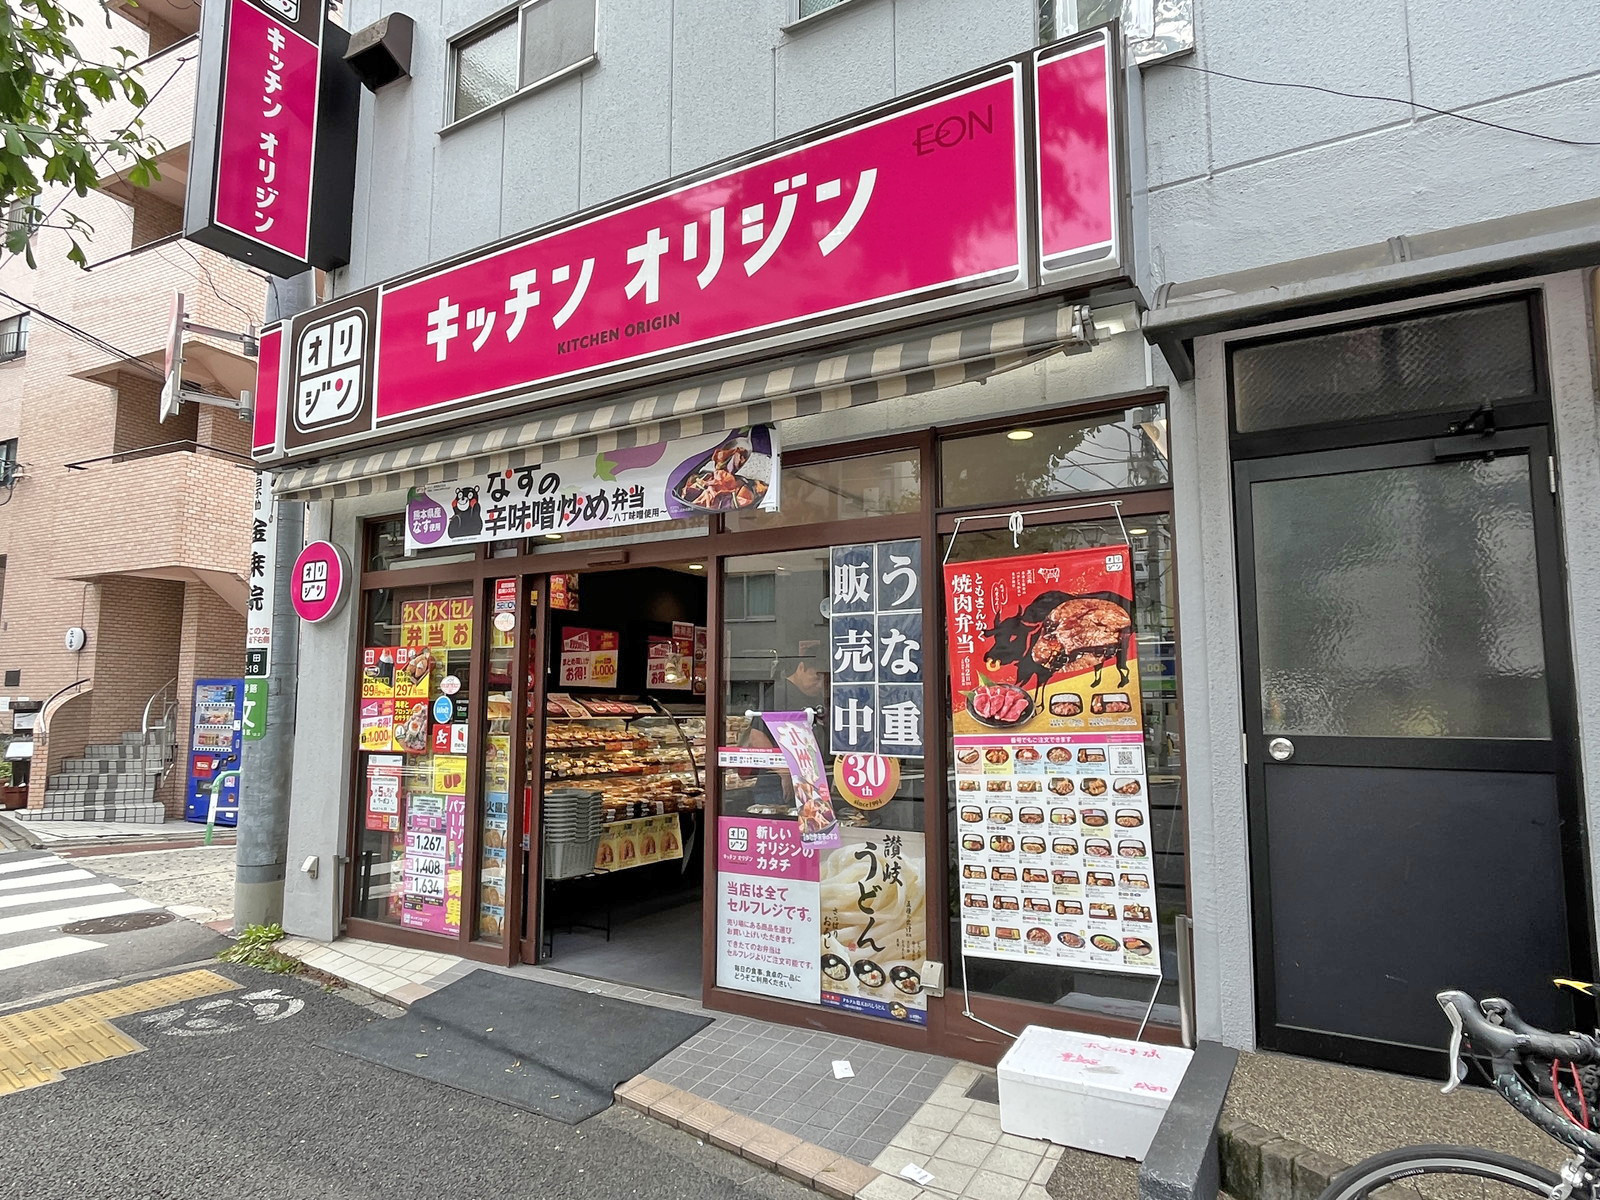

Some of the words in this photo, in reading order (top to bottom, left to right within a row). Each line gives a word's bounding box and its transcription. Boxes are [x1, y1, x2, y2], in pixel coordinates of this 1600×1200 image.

[263, 26, 286, 118] キッチン
[254, 132, 279, 233] オリジン
[426, 257, 595, 363] キッチン
[624, 168, 878, 305] オリジン
[557, 327, 620, 355] KITCHEN
[624, 311, 680, 338] ORIGIN
[487, 464, 561, 502] なすの
[951, 573, 974, 654] 焼肉弁当
[974, 572, 988, 642] ともさんかく
[245, 654, 261, 663] 田
[833, 562, 873, 745] 販売中
[880, 554, 923, 746] うな重
[444, 774, 461, 788] UP
[848, 755, 886, 787] 30
[861, 786, 873, 796] th
[756, 826, 791, 840] 新しい
[756, 841, 814, 859] オリジンの
[882, 834, 904, 887] 讃岐
[756, 857, 791, 872] カタチ
[727, 881, 788, 901] 当店は全て
[854, 841, 886, 953] うどん
[727, 898, 812, 922] セルフレジです。
[727, 919, 792, 934] 売り場にある商品を選び
[727, 928, 795, 945] お買い上げいただきます。
[727, 940, 781, 954] できたてのお弁当は
[727, 949, 813, 970] セルフレジよりご注文可能です。
